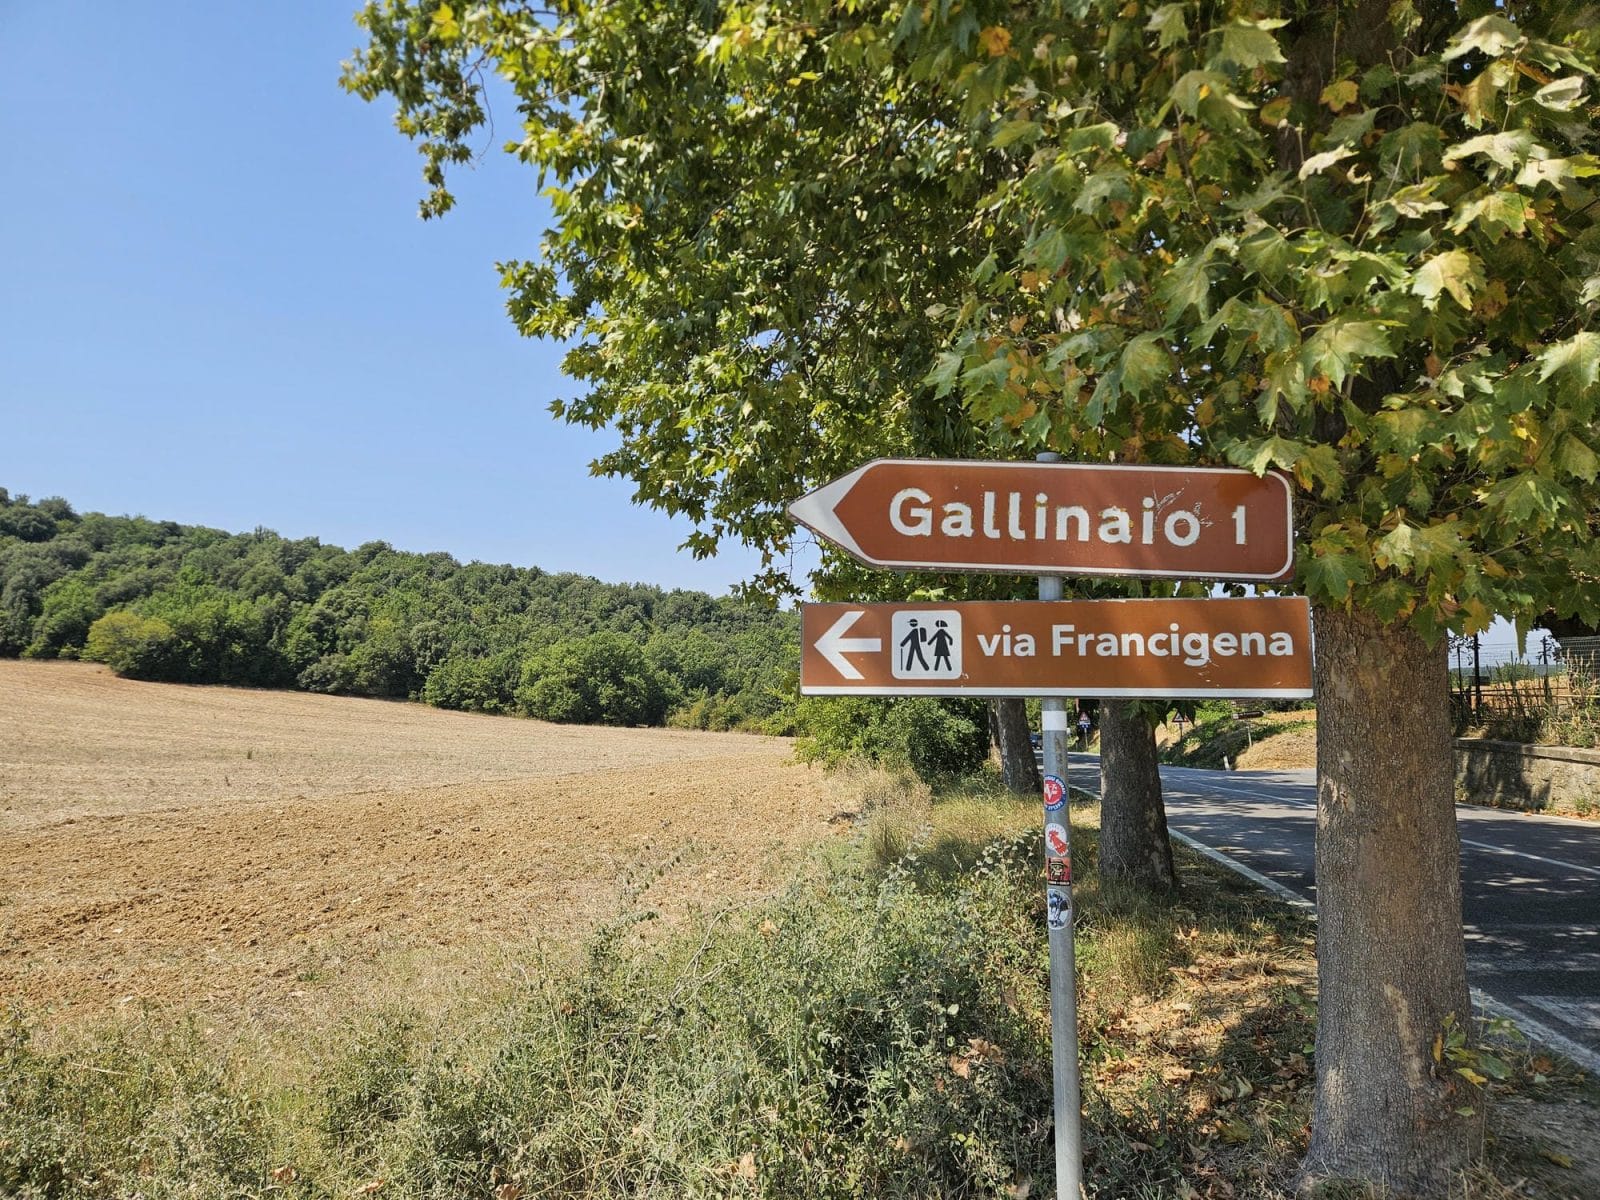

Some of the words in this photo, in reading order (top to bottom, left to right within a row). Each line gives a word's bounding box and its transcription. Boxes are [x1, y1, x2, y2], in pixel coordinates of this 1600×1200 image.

[889, 487, 1201, 547] Gallinaio
[1231, 504, 1247, 545] 1
[976, 624, 1036, 657] via
[1051, 622, 1295, 667] Francigena
